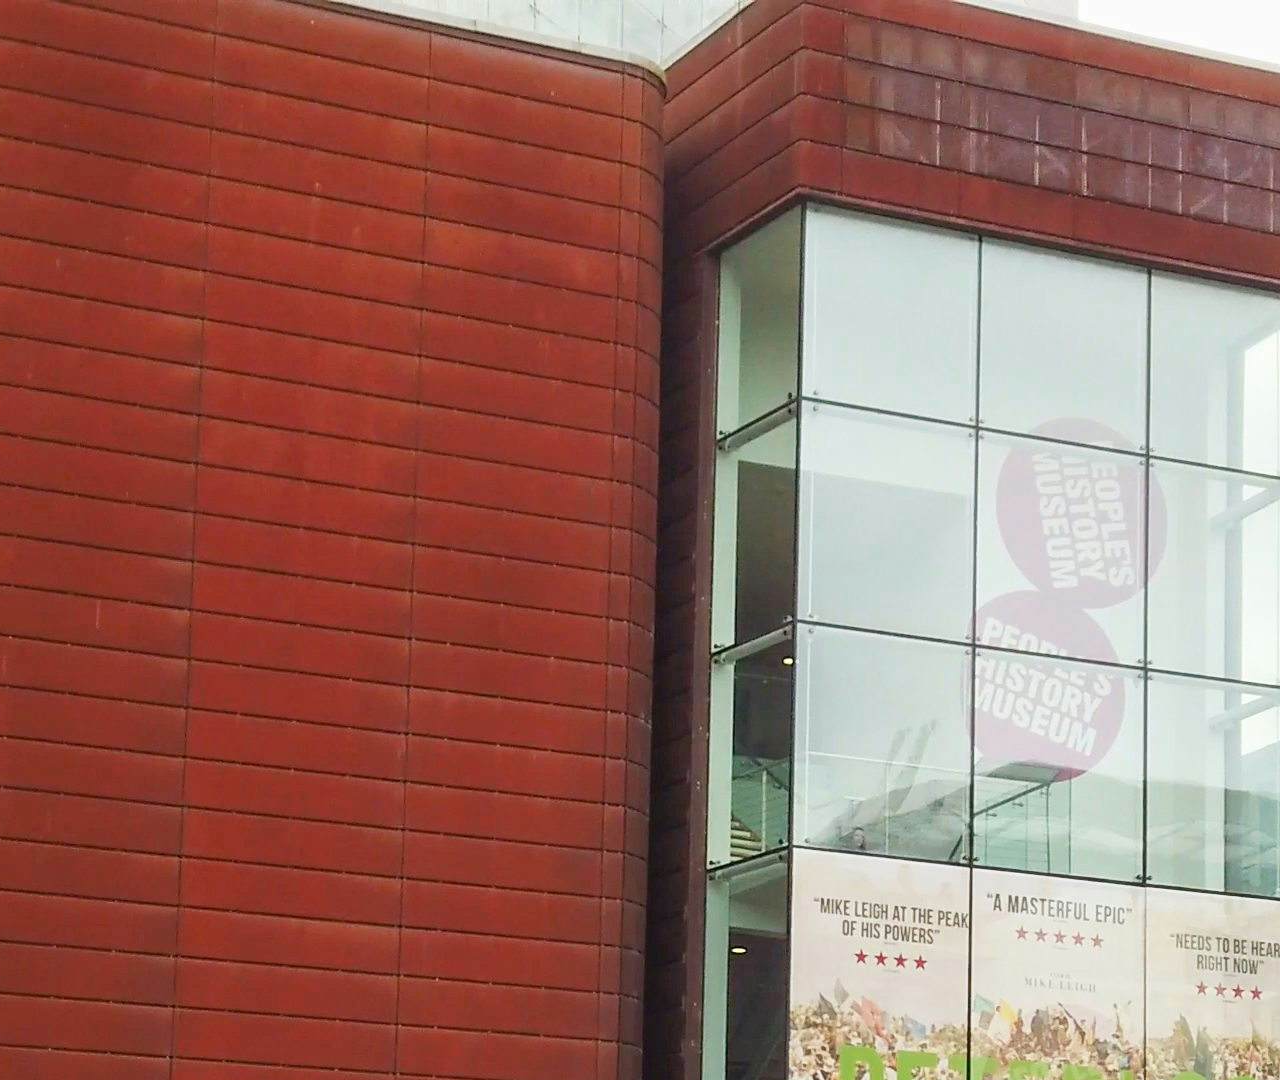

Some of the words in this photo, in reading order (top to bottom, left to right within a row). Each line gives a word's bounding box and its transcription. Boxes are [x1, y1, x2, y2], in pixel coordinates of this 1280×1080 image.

[854, 901, 889, 920] LEIGH
[892, 905, 907, 922] AT
[911, 907, 934, 925] THE
[937, 910, 969, 928] PEAK
[1007, 894, 1090, 922] MASTERFUL
[842, 920, 857, 936] OF
[861, 922, 881, 939] HIS
[1215, 937, 1230, 954] TO
[1233, 938, 1248, 955] BE
[1196, 954, 1230, 973] RIGHT
